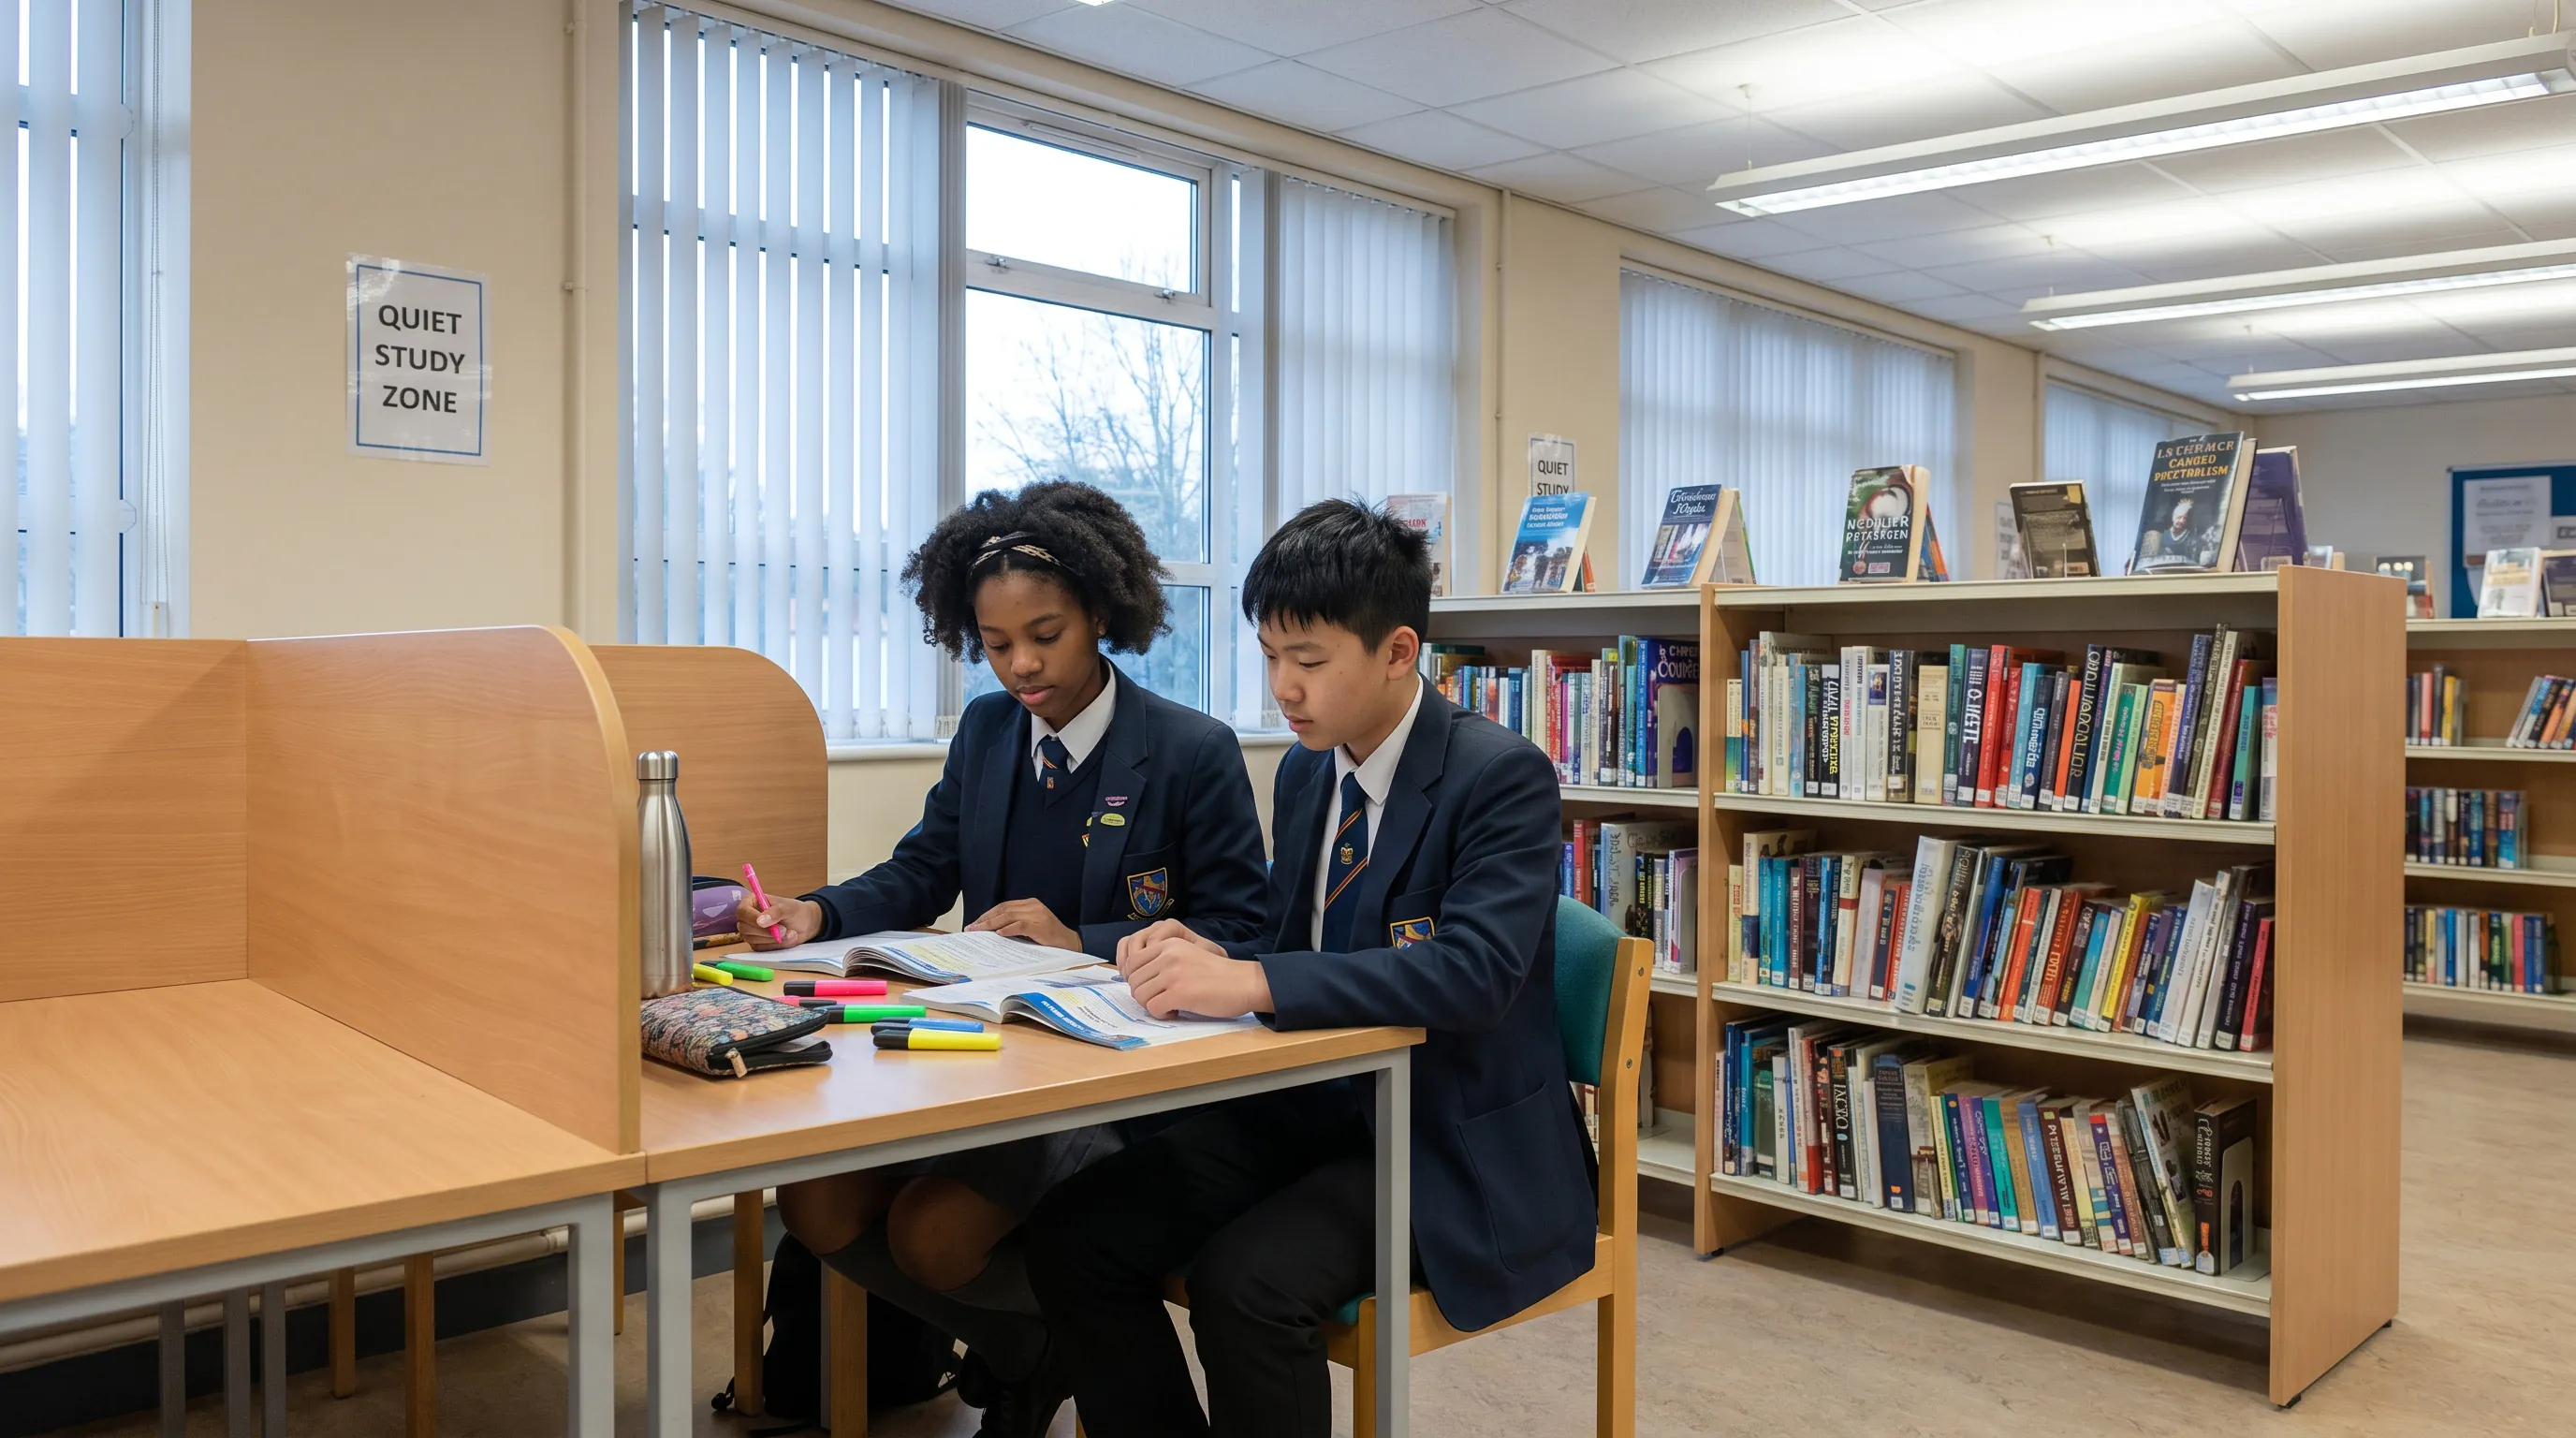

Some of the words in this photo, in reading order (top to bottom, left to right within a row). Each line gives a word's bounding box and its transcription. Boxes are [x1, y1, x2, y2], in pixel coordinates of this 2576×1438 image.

[378, 304, 462, 334] QUIET
[374, 344, 465, 374] STUDY
[382, 385, 458, 414] ZONE
[1538, 460, 1569, 476] QUIET
[1536, 482, 1570, 496] STUDY
